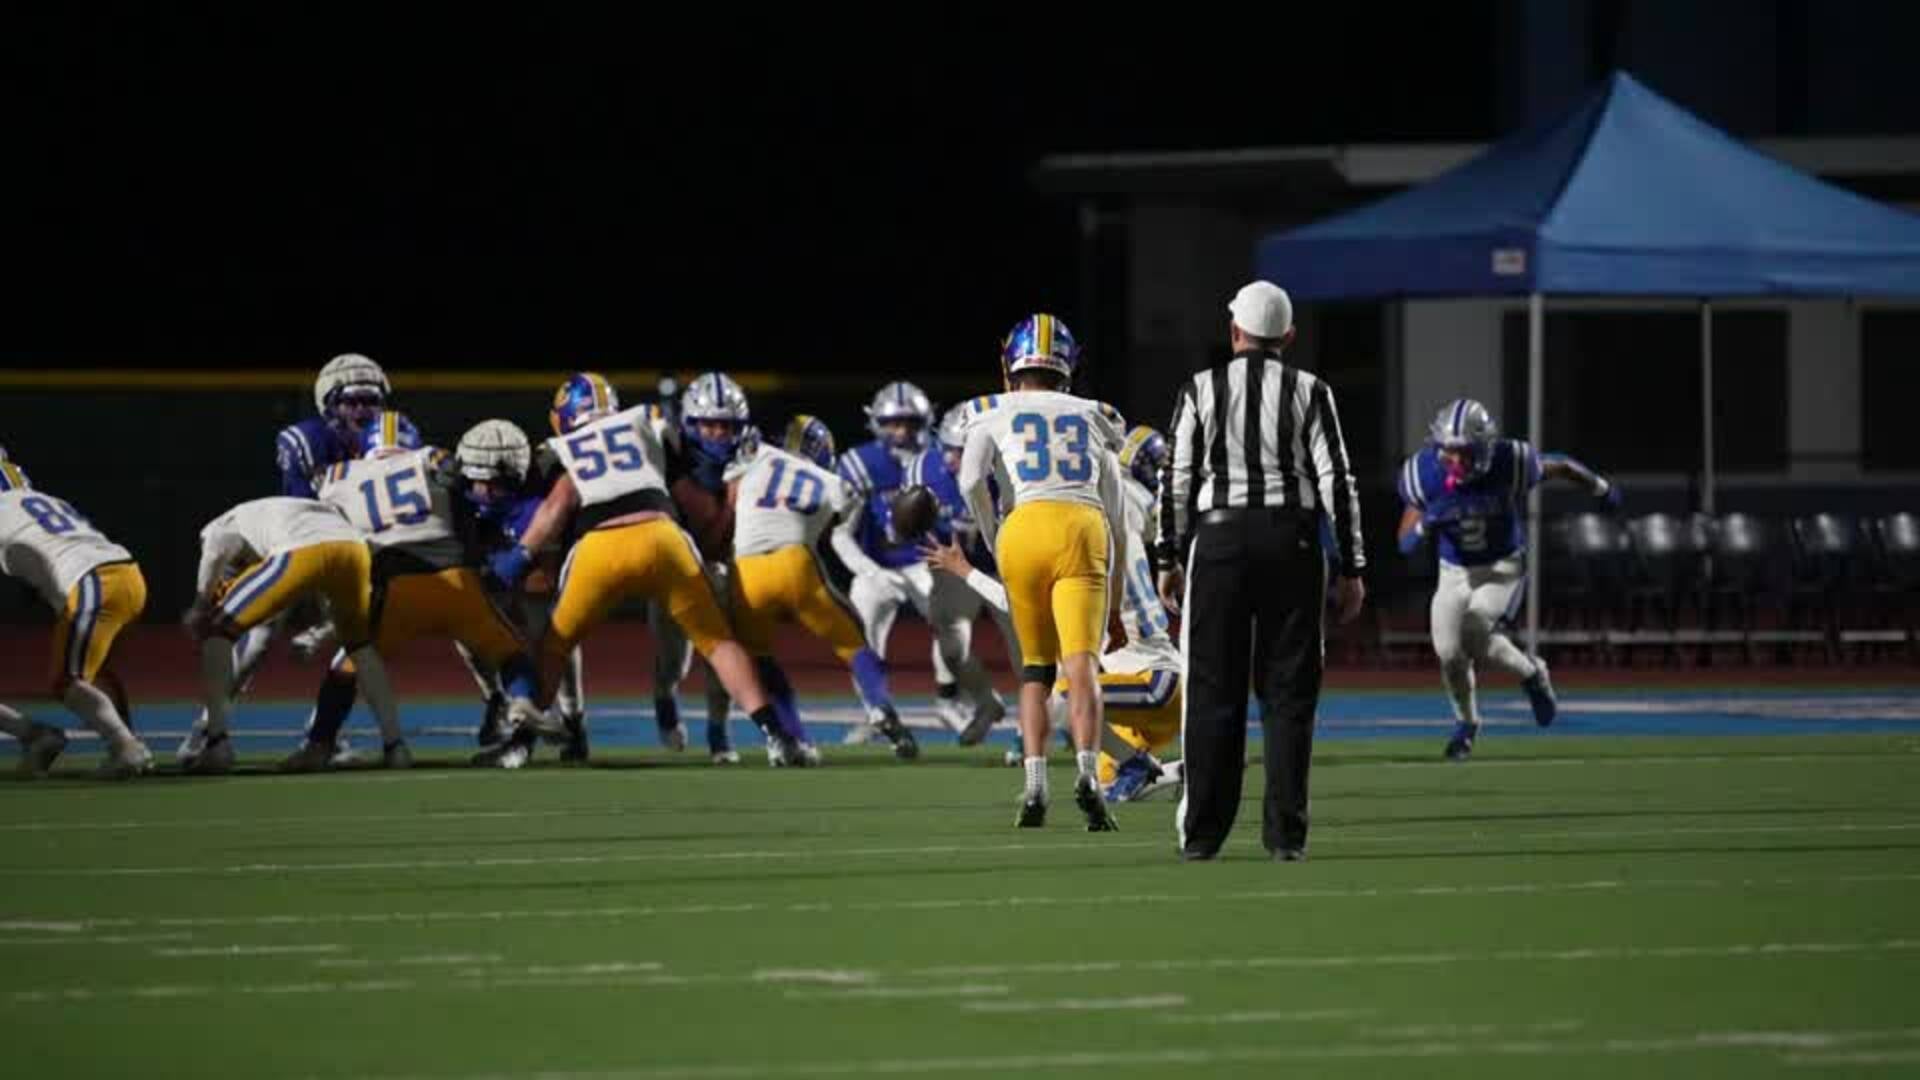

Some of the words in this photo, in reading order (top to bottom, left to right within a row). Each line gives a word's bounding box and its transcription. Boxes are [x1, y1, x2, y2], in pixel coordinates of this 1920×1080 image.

[566, 424, 643, 482] 55
[1011, 412, 1093, 482] 33
[359, 466, 430, 533] 15
[756, 457, 824, 514] 10
